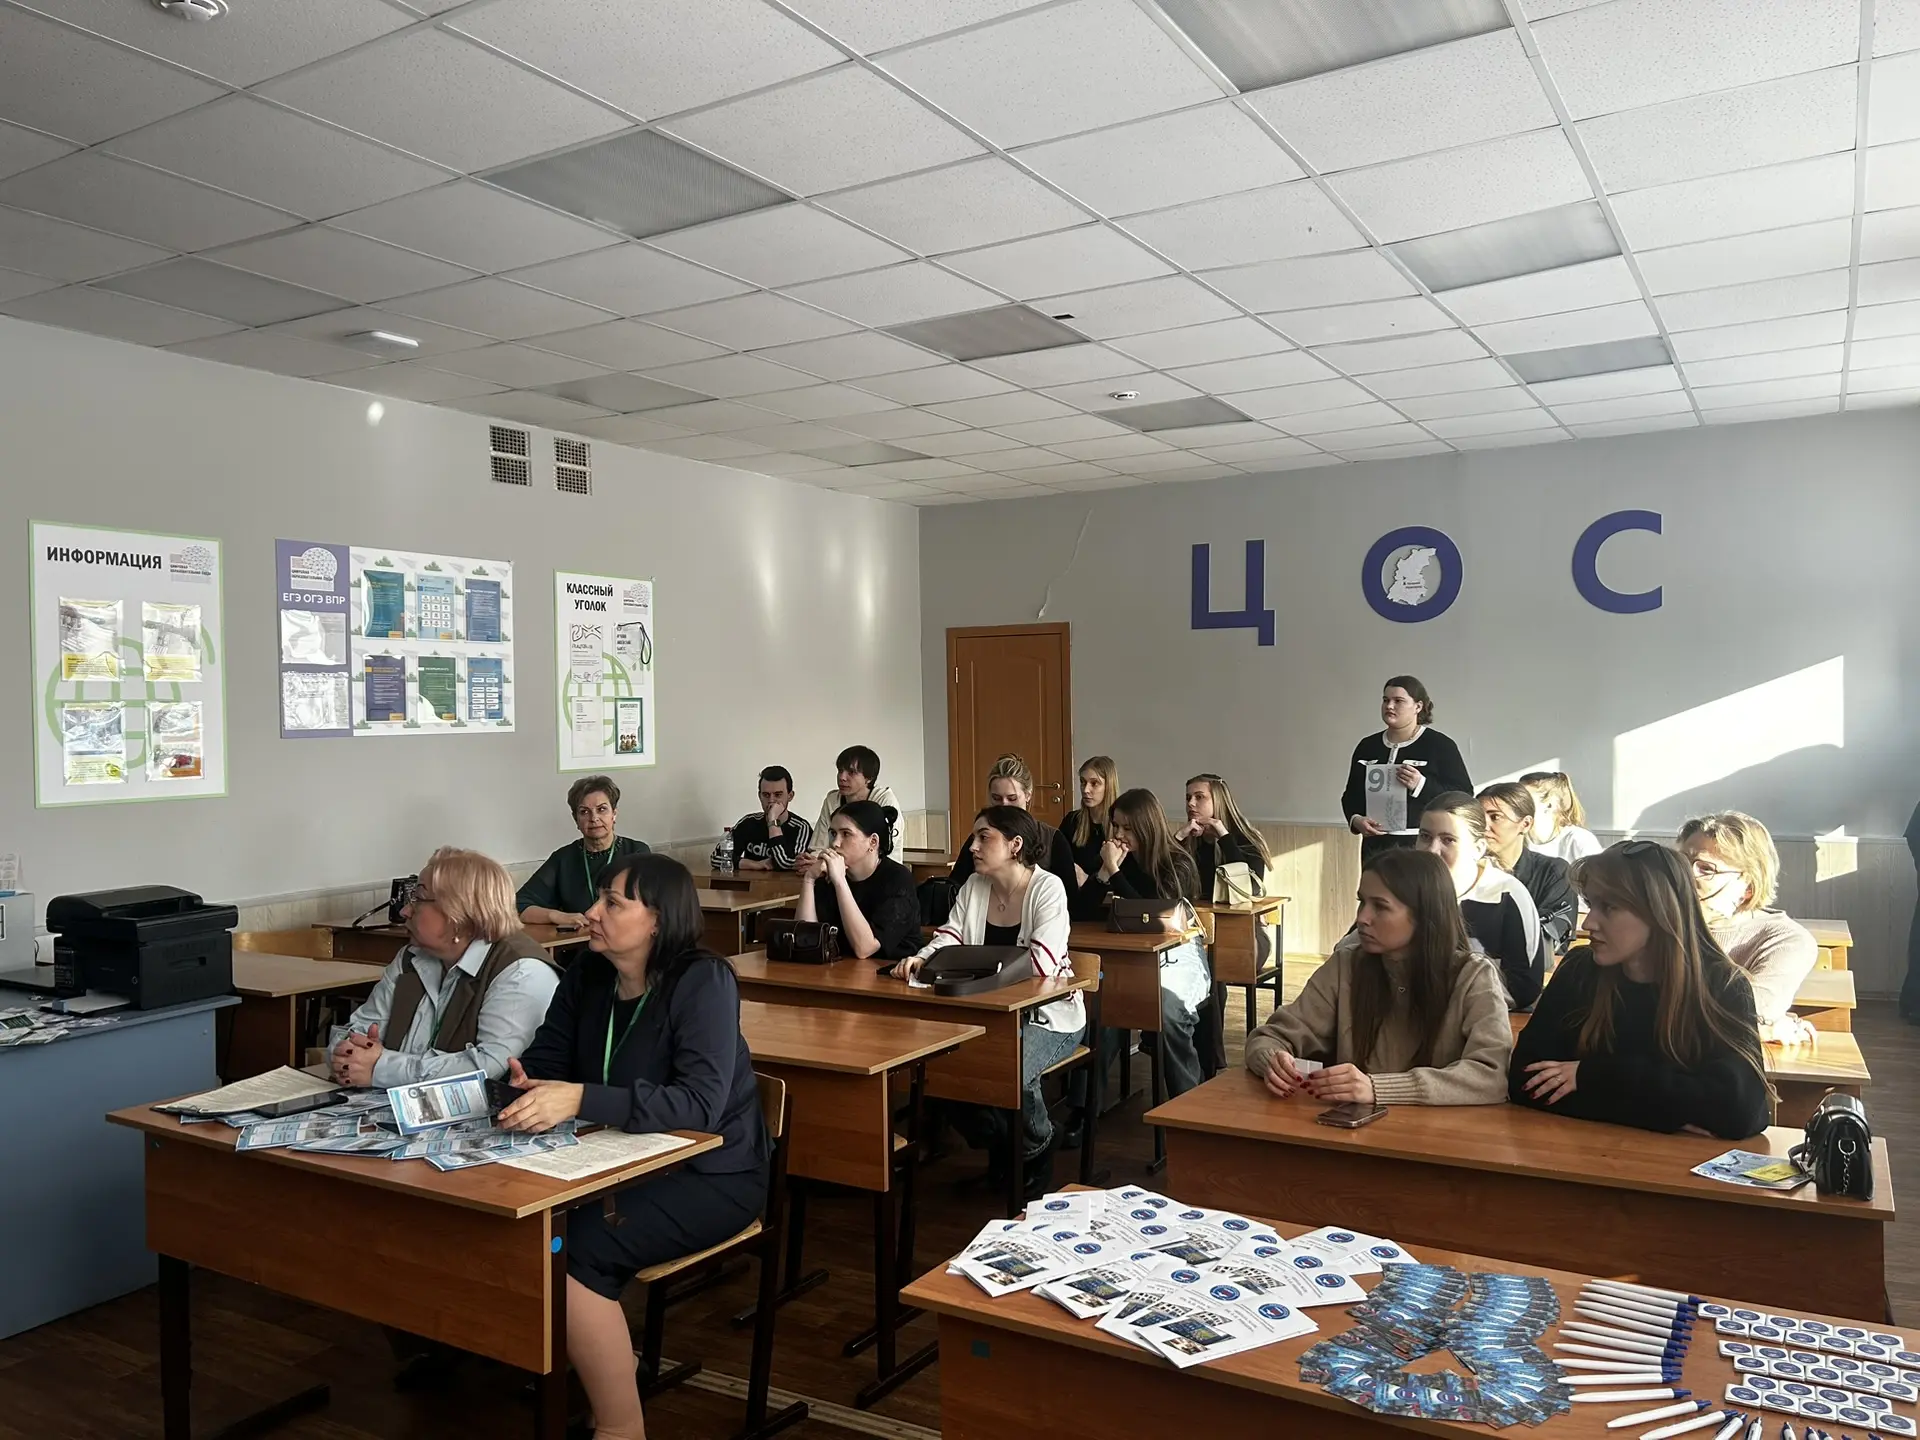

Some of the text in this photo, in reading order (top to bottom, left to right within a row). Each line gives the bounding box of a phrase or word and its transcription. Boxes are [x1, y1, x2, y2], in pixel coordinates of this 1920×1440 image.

[46, 546, 162, 570] ИНФОРМАЦИЯ
[566, 582, 614, 597] КЛАССНЫЙ
[283, 592, 346, 605] ЕГЭ ОГЭ ВПР
[574, 599, 607, 612] УГОЛОК
[1368, 768, 1385, 793] 9
